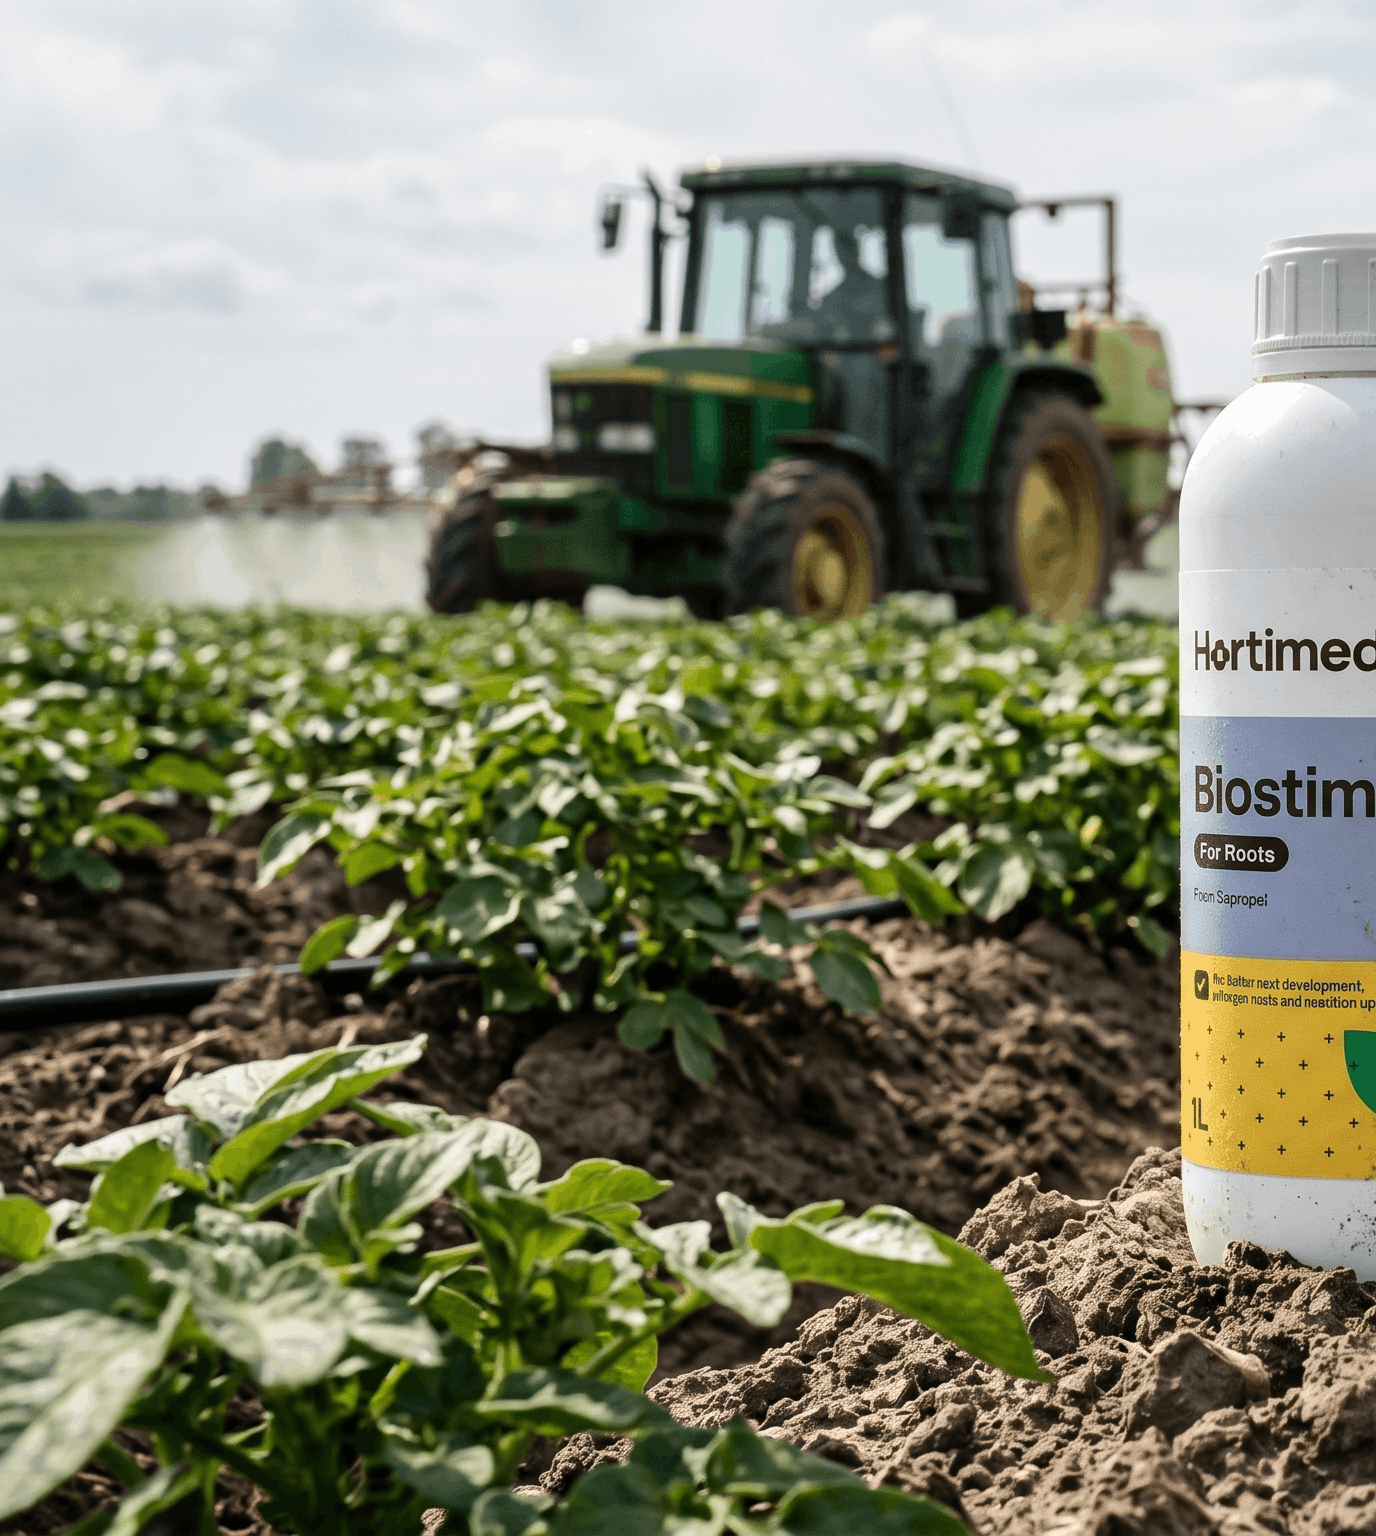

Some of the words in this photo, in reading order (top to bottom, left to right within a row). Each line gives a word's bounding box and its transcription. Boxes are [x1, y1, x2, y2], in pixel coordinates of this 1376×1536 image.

[1200, 842, 1222, 860] For
[1224, 843, 1276, 864] Roots
[1256, 978, 1280, 990] next
[1282, 977, 1365, 995] development,
[1280, 994, 1303, 1008] and
[1191, 1096, 1209, 1132] 1L
